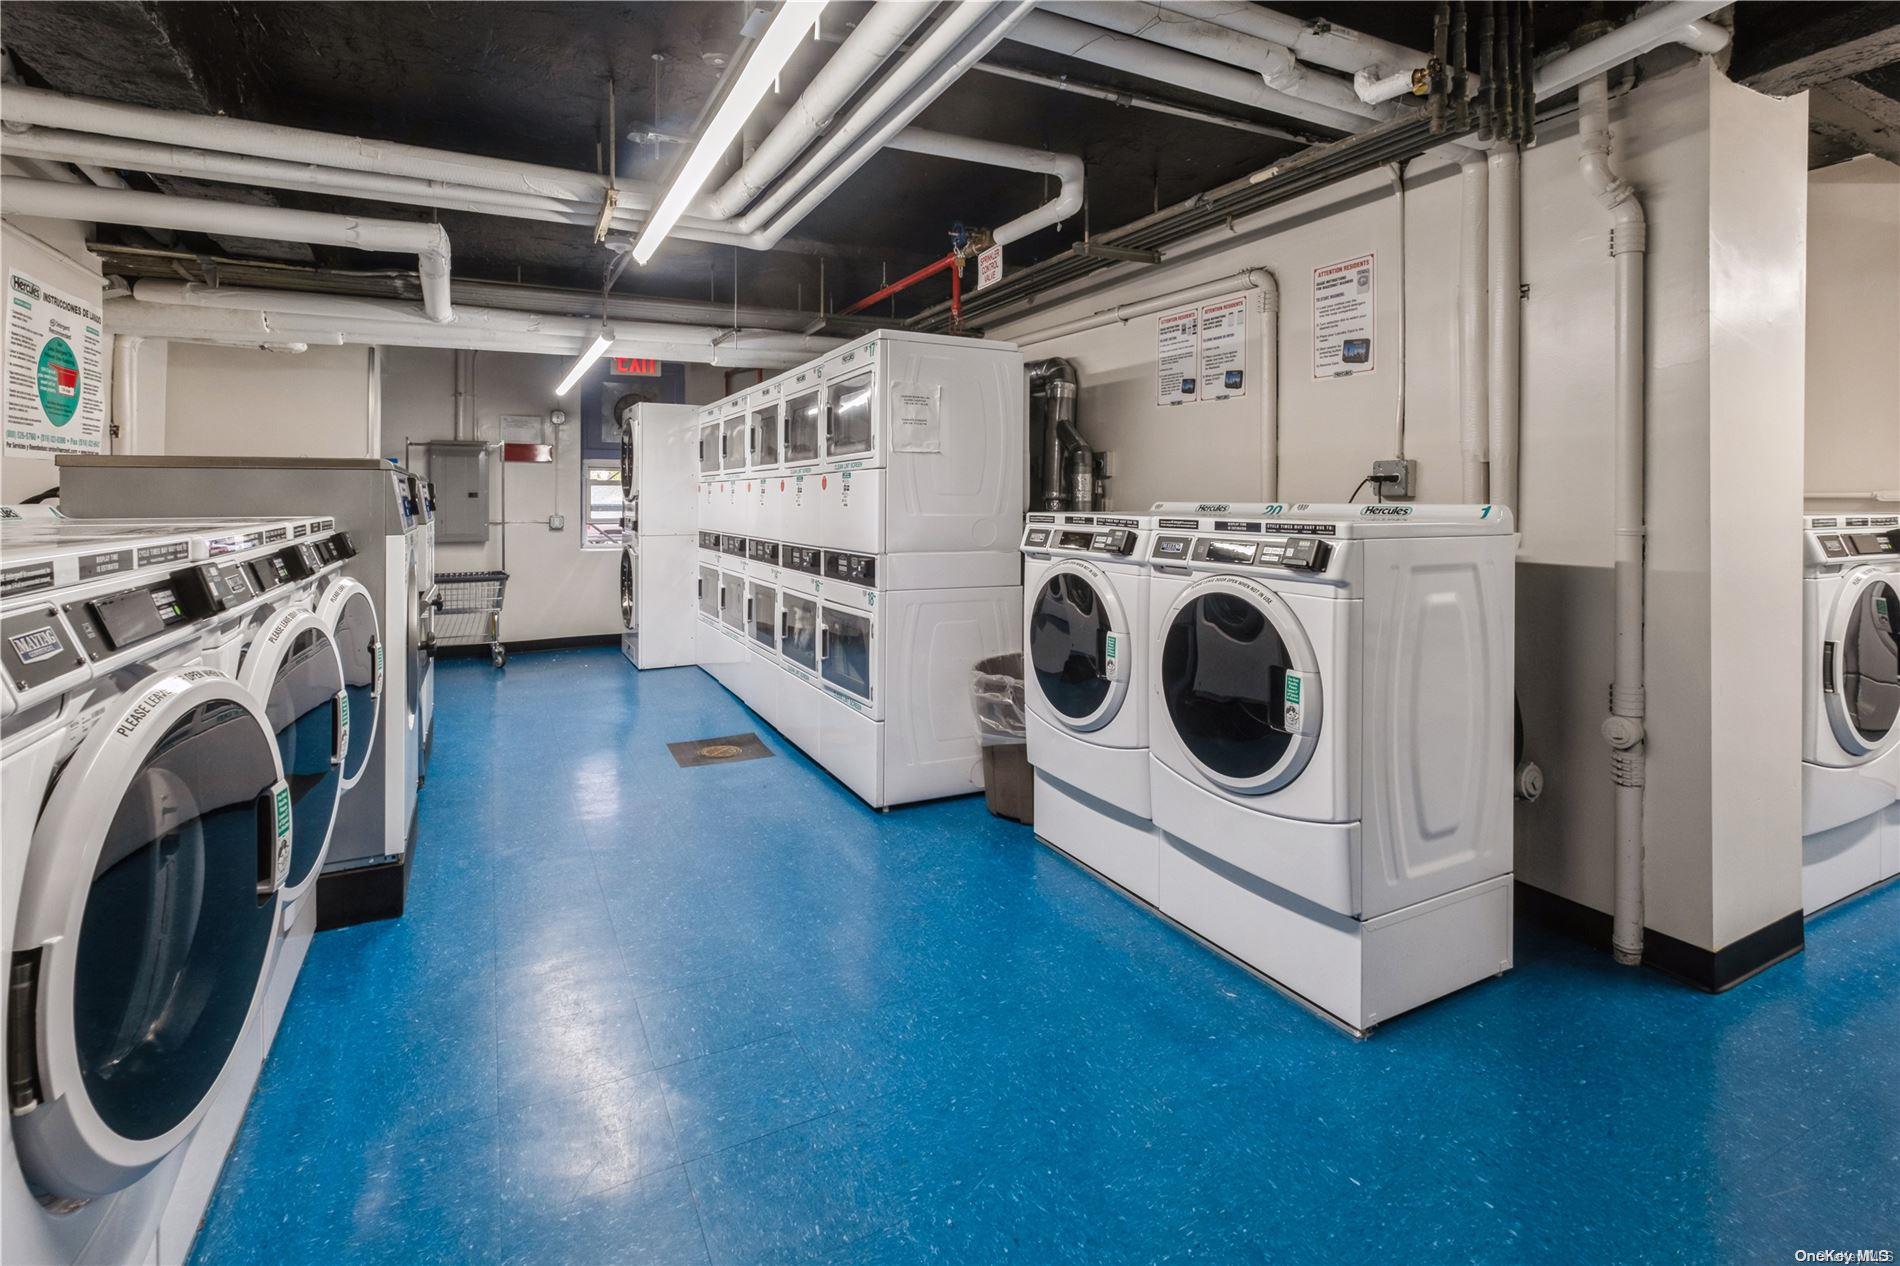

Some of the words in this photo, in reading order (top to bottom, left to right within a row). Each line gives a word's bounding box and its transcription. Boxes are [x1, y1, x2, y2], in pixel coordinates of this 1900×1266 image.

[1318, 267, 1342, 278] ATTENTION
[1344, 260, 1370, 270] RESIDENTS
[13, 276, 40, 298] Hercules
[42, 292, 82, 316] INSTRUCCIONES
[1198, 504, 1228, 512] Hercules
[1264, 505, 1282, 515] 20
[1365, 506, 1409, 516] Hercules
[1480, 506, 1492, 519] 1
[96, 554, 110, 564] DISPLAY
[101, 562, 118, 572] ESTIMATED
[1238, 580, 1250, 589] WHEN
[1263, 596, 1272, 605] USE
[269, 625, 284, 644] PLEASE
[281, 615, 292, 628] LEAVE
[14, 630, 56, 654] MAYTAG
[116, 704, 149, 737] PLEASE
[145, 688, 176, 713] LEAVE
[184, 671, 204, 680] OPEN
